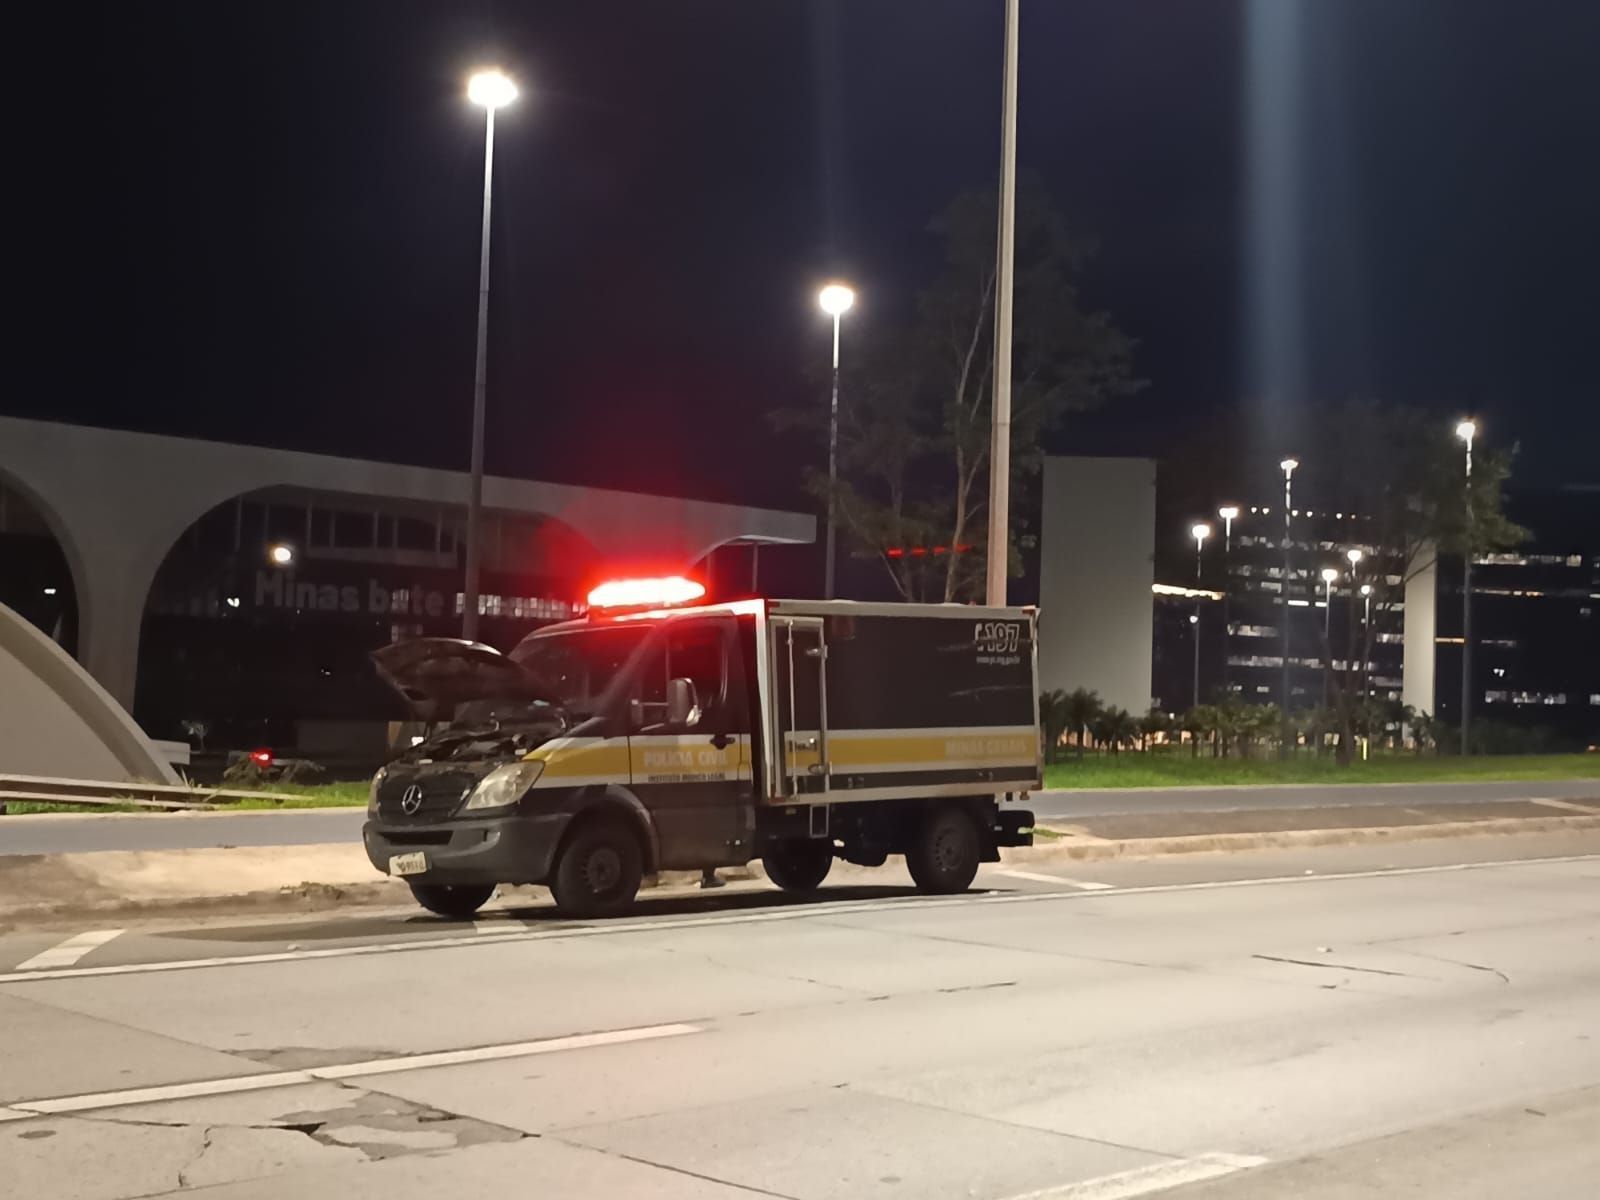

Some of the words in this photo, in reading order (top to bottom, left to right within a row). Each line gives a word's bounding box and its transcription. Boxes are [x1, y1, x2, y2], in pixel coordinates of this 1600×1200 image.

[255, 570, 360, 612] Minas
[369, 578, 445, 617] bate
[985, 622, 1020, 652] 197
[698, 751, 727, 767] CIVIL
